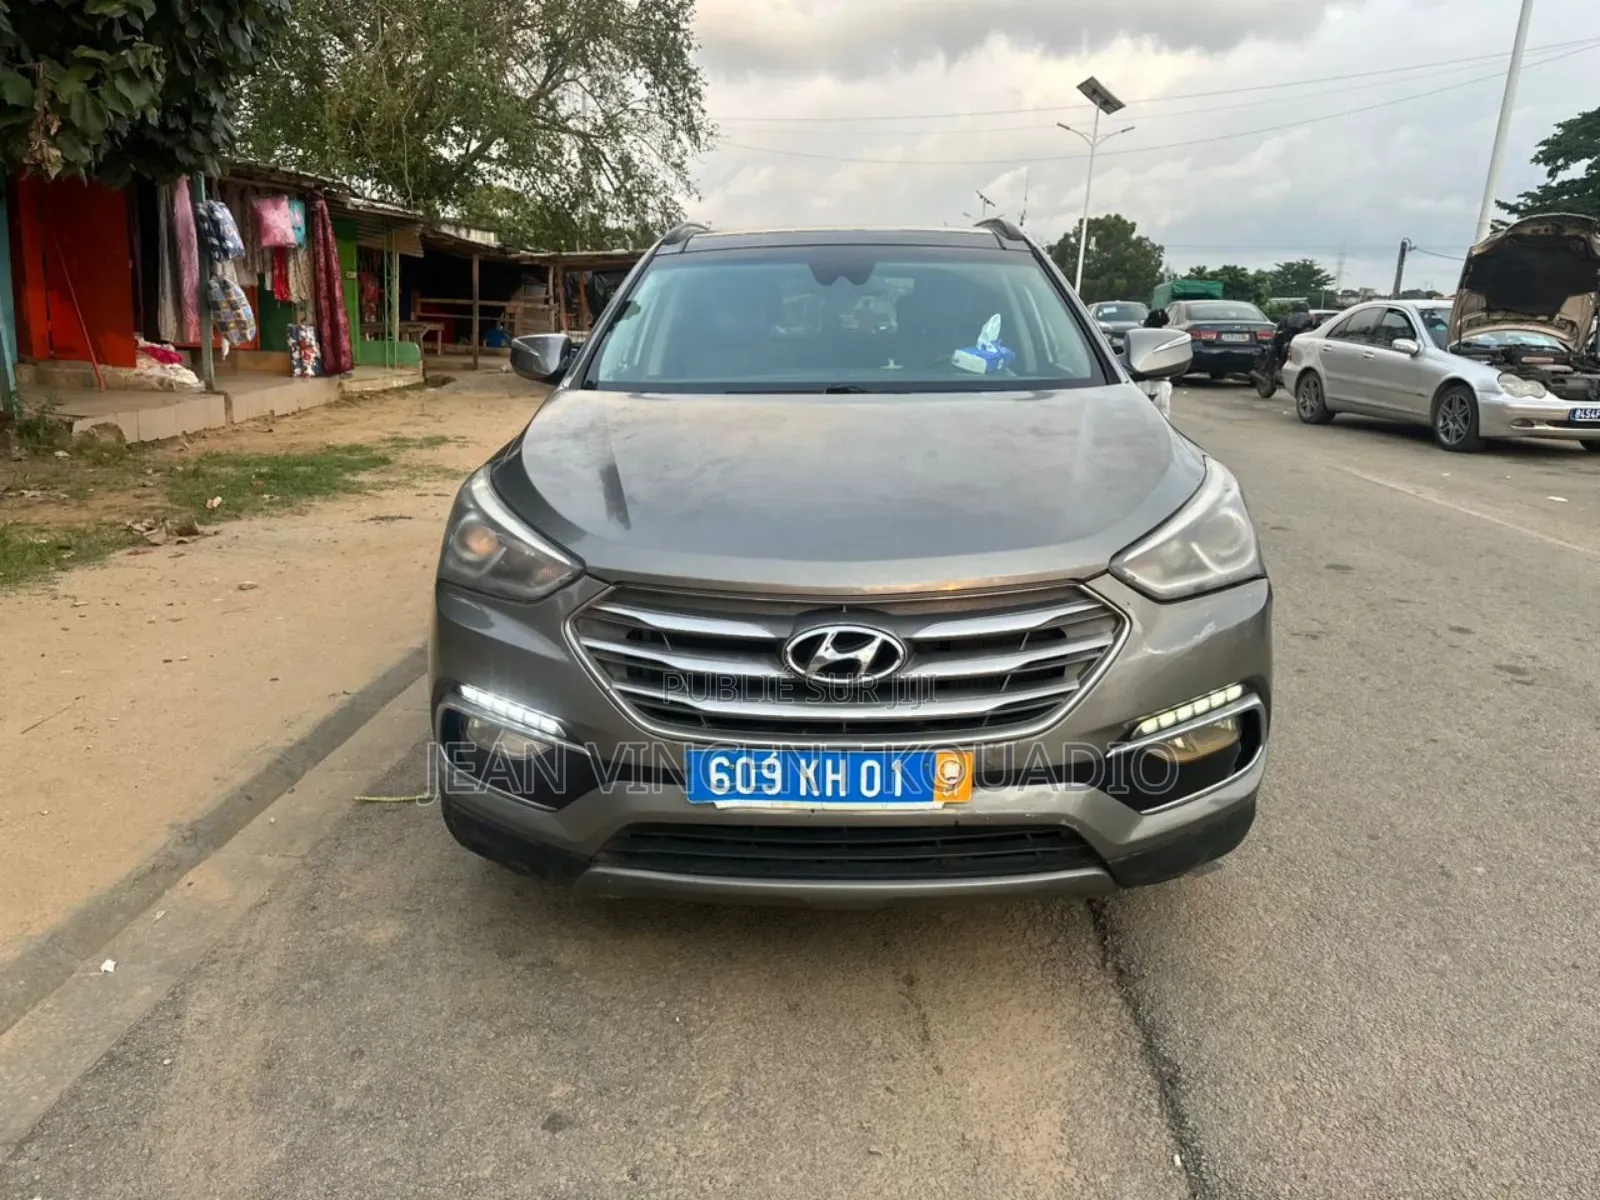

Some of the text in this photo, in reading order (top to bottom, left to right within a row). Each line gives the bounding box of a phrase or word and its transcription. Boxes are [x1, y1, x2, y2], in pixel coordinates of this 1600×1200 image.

[709, 756, 902, 798] 609 KH 01
